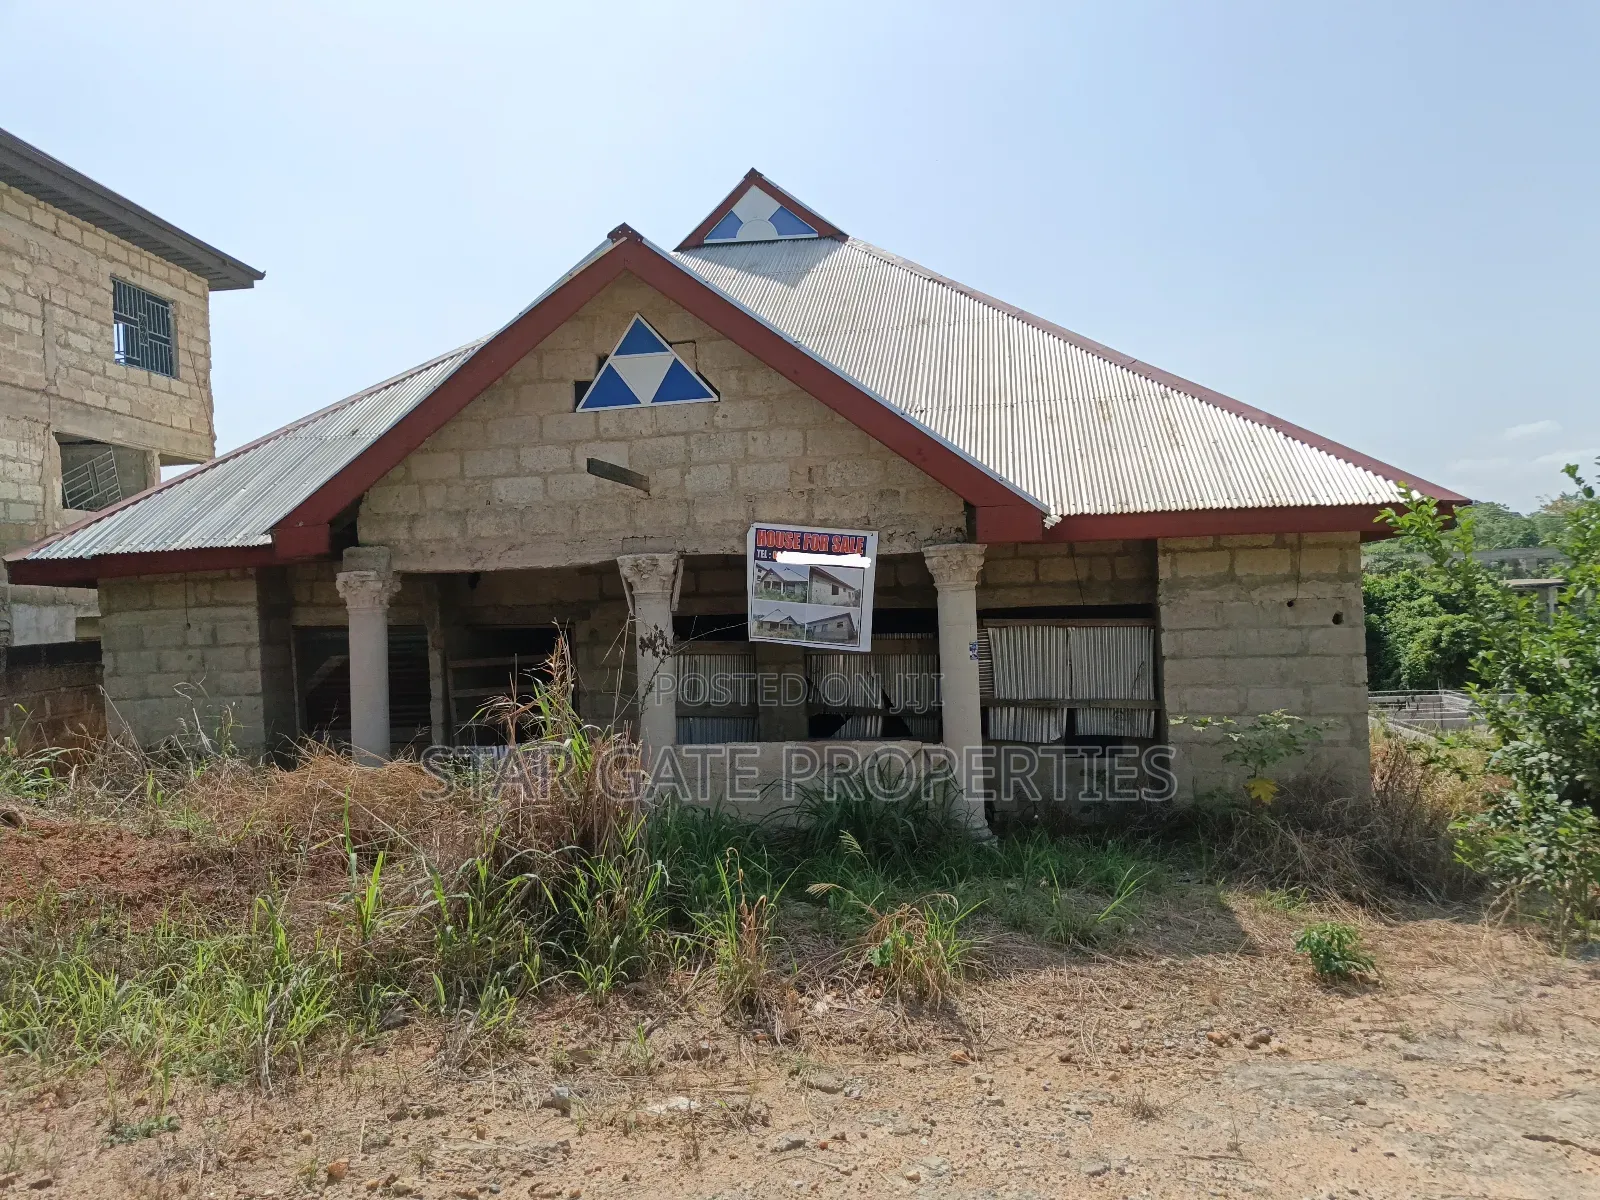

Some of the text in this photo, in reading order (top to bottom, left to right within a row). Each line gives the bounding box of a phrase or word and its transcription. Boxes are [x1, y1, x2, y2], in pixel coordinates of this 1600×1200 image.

[756, 529, 865, 555] HOUSE FOR SALE
